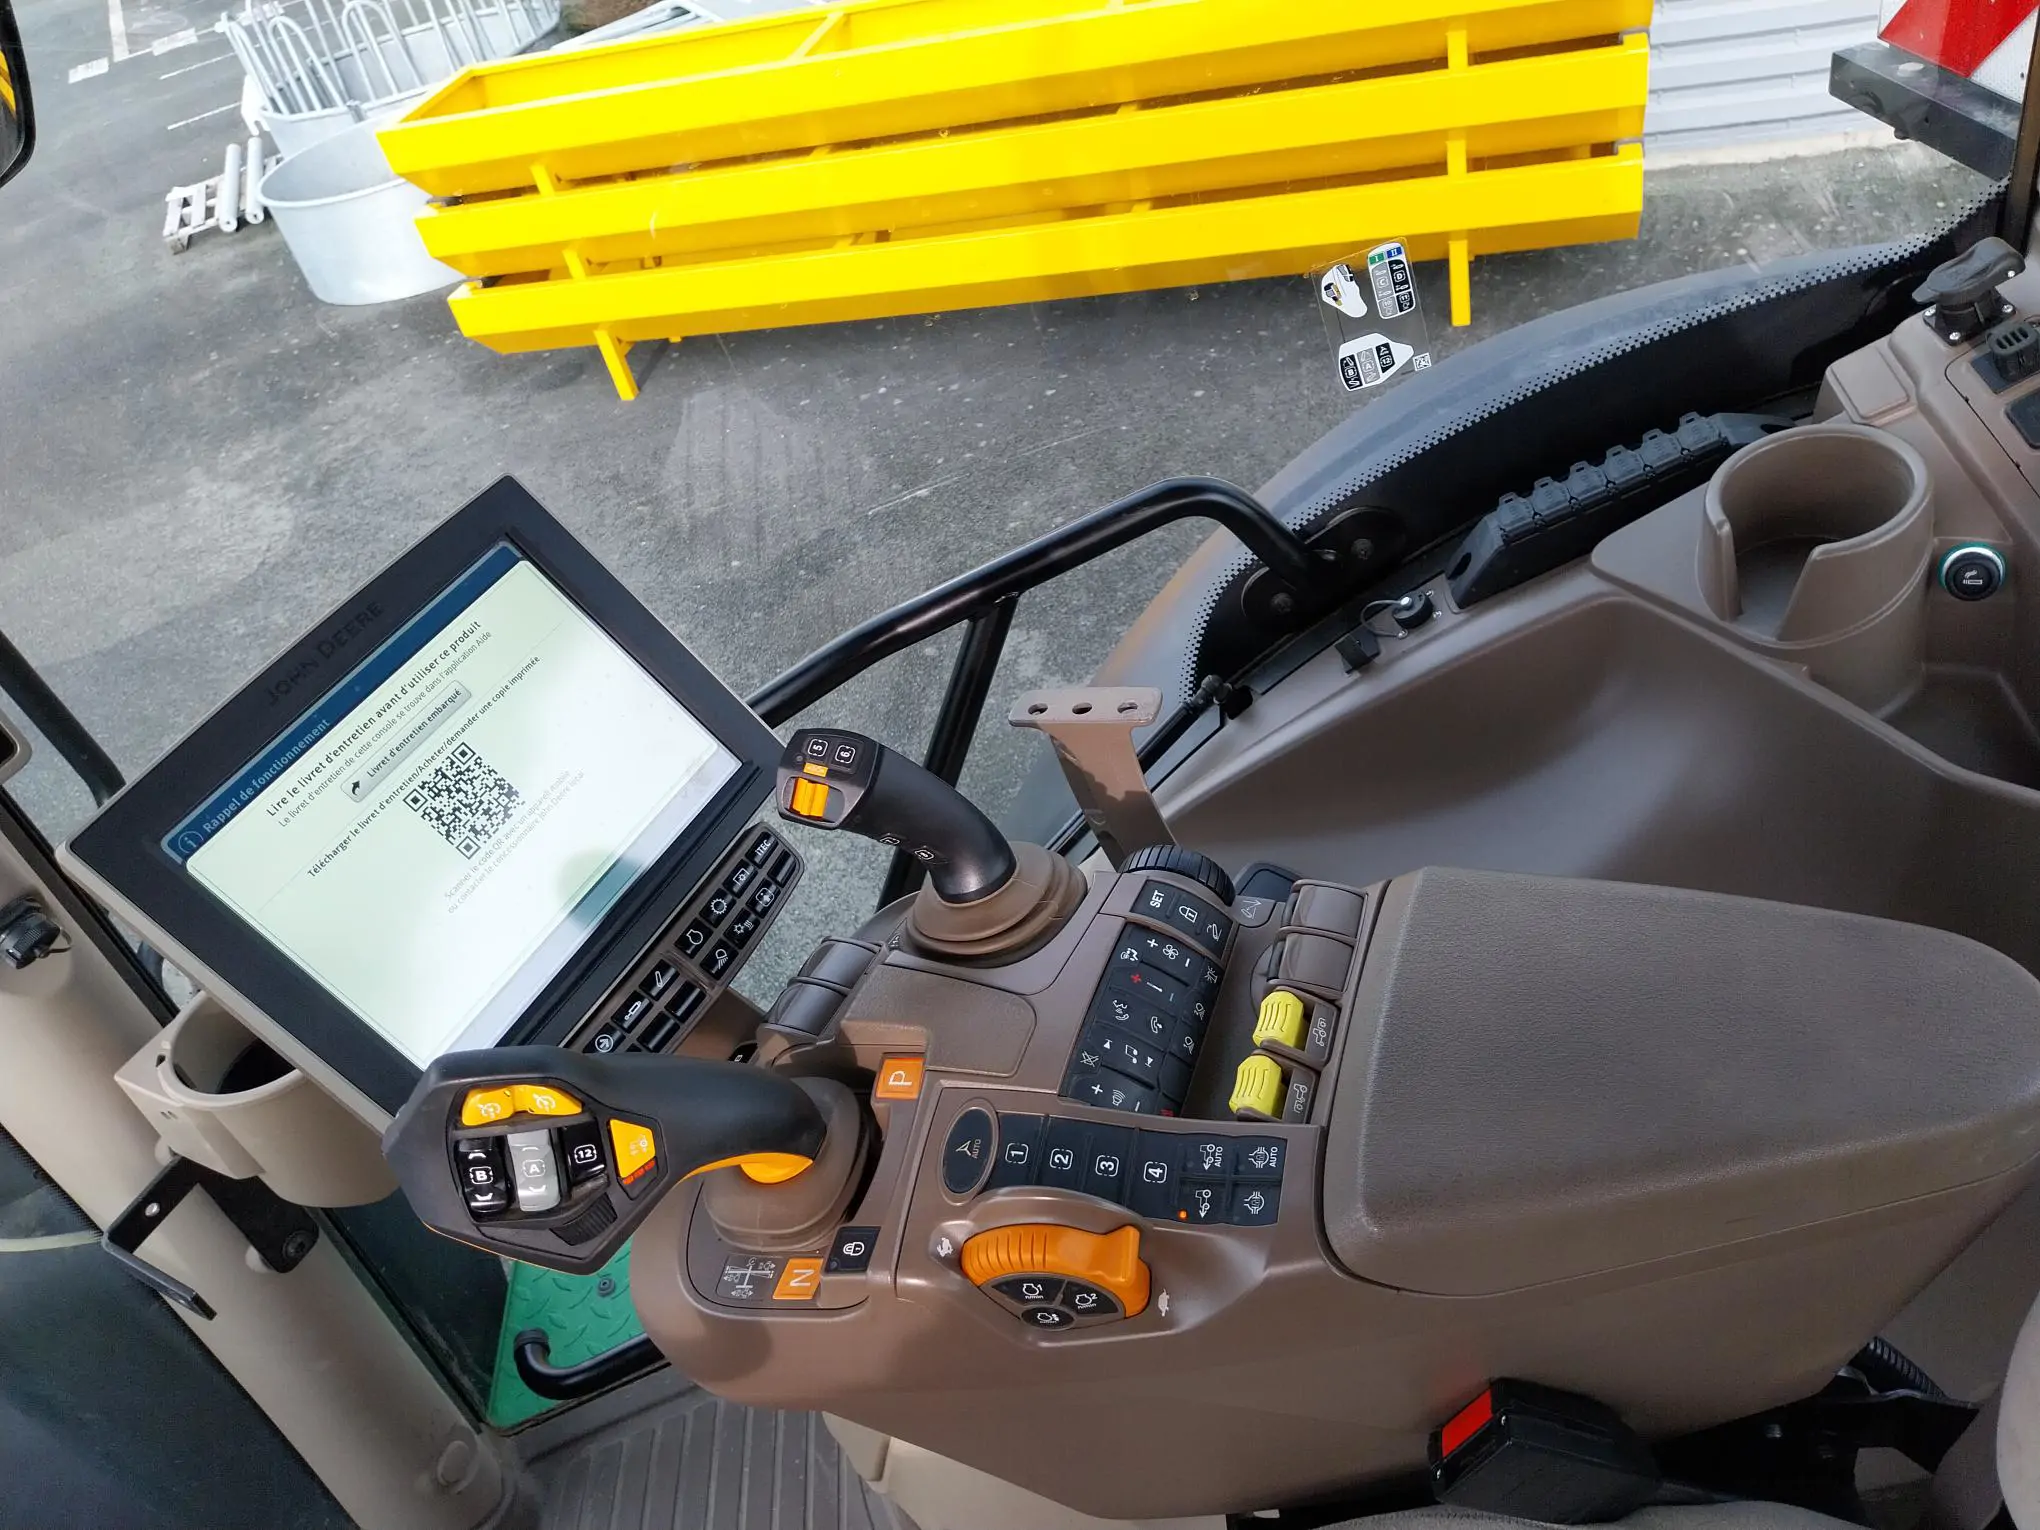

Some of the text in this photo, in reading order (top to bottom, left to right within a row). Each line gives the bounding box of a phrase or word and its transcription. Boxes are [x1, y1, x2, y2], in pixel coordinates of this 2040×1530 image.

[316, 600, 383, 659] DEERE
[266, 621, 481, 816] Lire le livret d'entretien avant d'utiliser ce produit
[278, 631, 491, 827] Le livret d'entretien de cette console se trouve dans l'application Aide
[366, 688, 462, 777] Livret d'entretien embarqué
[202, 719, 330, 833] Rappel de fonctionnement
[307, 835, 352, 877] Télécharger
[349, 828, 360, 837] le
[357, 809, 380, 829] livret
[478, 701, 493, 714] une
[492, 684, 510, 702] copie
[507, 656, 540, 686] imprimée
[1149, 889, 1165, 908] SET
[888, 1070, 913, 1086] P
[578, 1148, 593, 1159] 12
[971, 1138, 982, 1159] AUTO
[1214, 1146, 1224, 1168] AUTO
[1269, 1146, 1279, 1168] AUTO
[529, 1163, 540, 1174] A
[1054, 1154, 1069, 1165] 2
[1099, 1160, 1115, 1171] 3
[475, 1170, 488, 1181] B
[1148, 1167, 1163, 1178] 4
[789, 1268, 815, 1287] N
